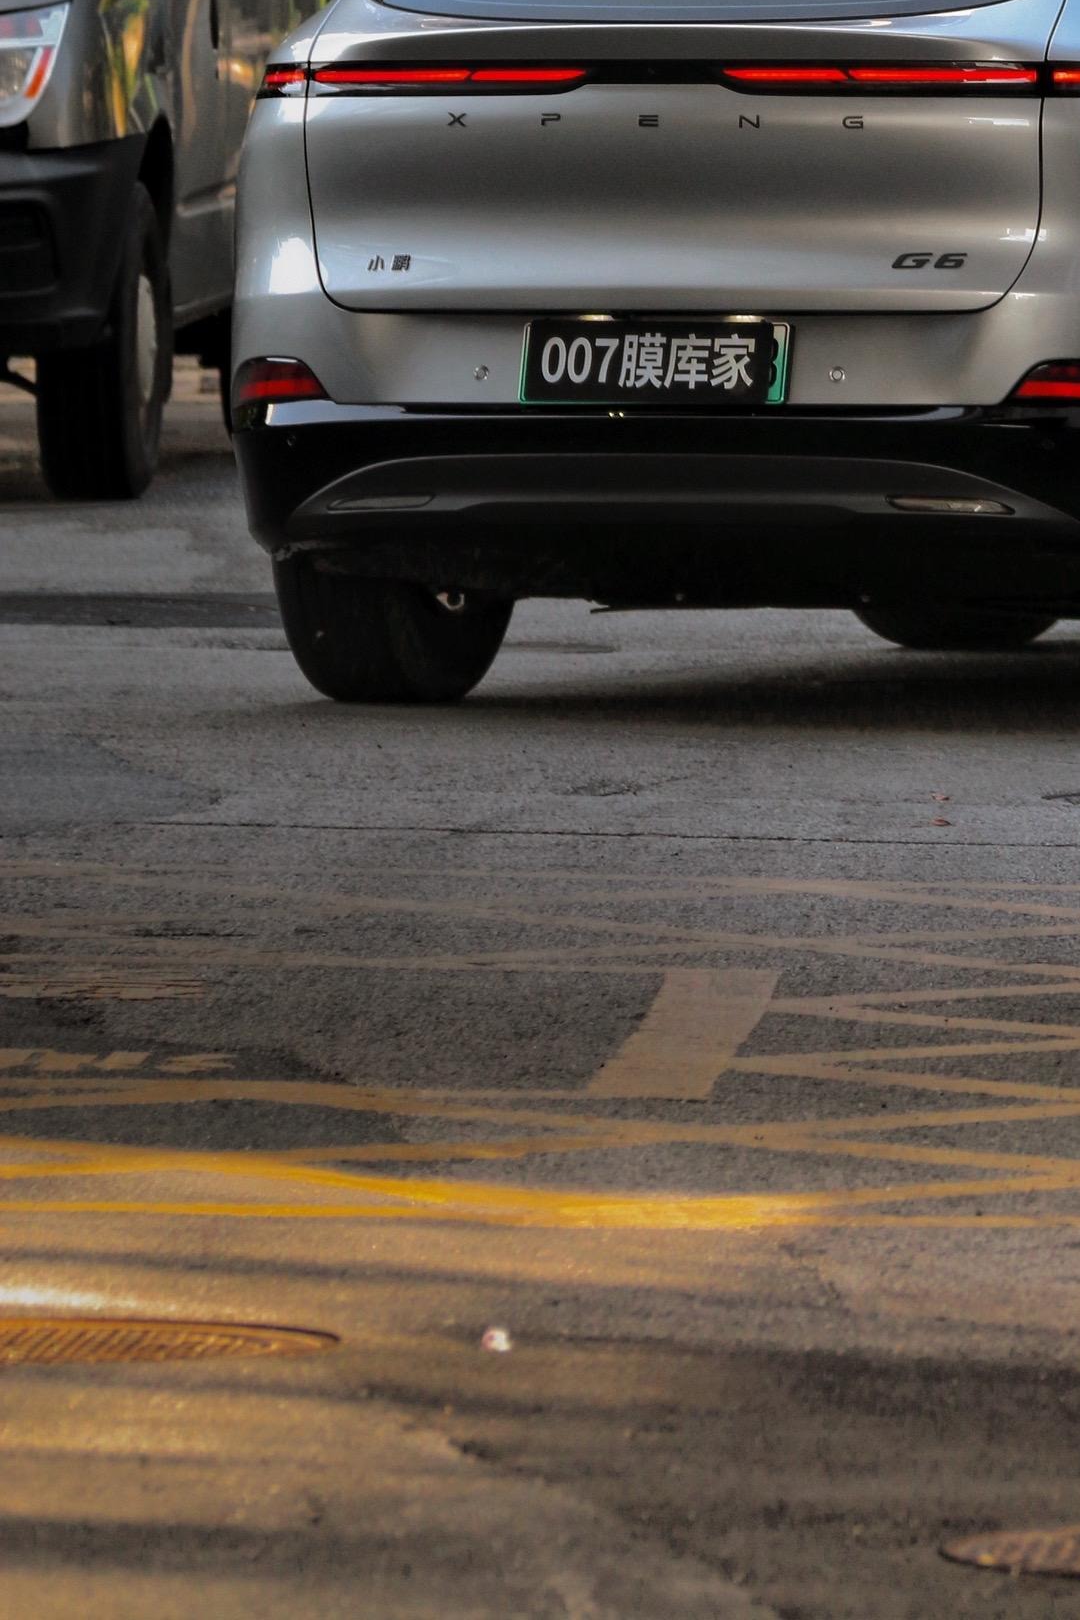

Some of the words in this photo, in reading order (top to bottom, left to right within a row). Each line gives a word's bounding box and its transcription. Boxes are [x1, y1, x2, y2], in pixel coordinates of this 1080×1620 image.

[447, 112, 864, 130] XPENG
[367, 254, 411, 271] 小鹏
[891, 252, 968, 269] G6
[541, 333, 755, 390] 007膜库家
